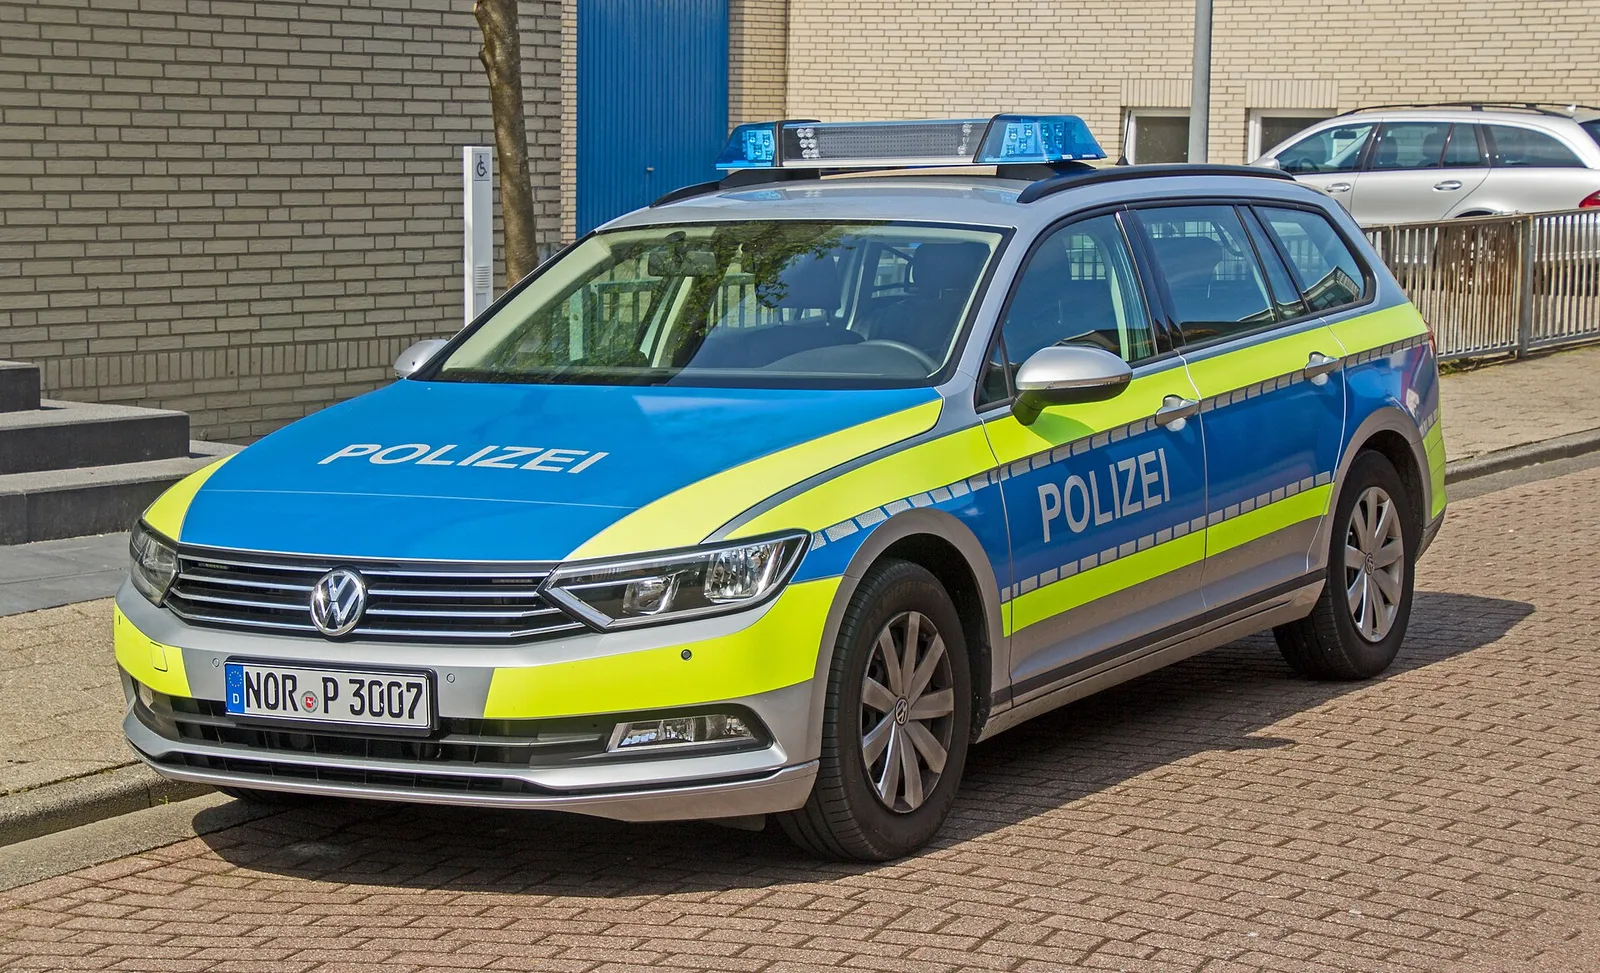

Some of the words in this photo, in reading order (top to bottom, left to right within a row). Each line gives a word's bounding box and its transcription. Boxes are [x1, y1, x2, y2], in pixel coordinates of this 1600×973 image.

[317, 443, 610, 474] POLIZEI
[1037, 448, 1170, 543] POLIZEI
[232, 692, 240, 704] D
[245, 671, 298, 711] NOR
[322, 677, 339, 713] P
[349, 678, 422, 719] 3007
